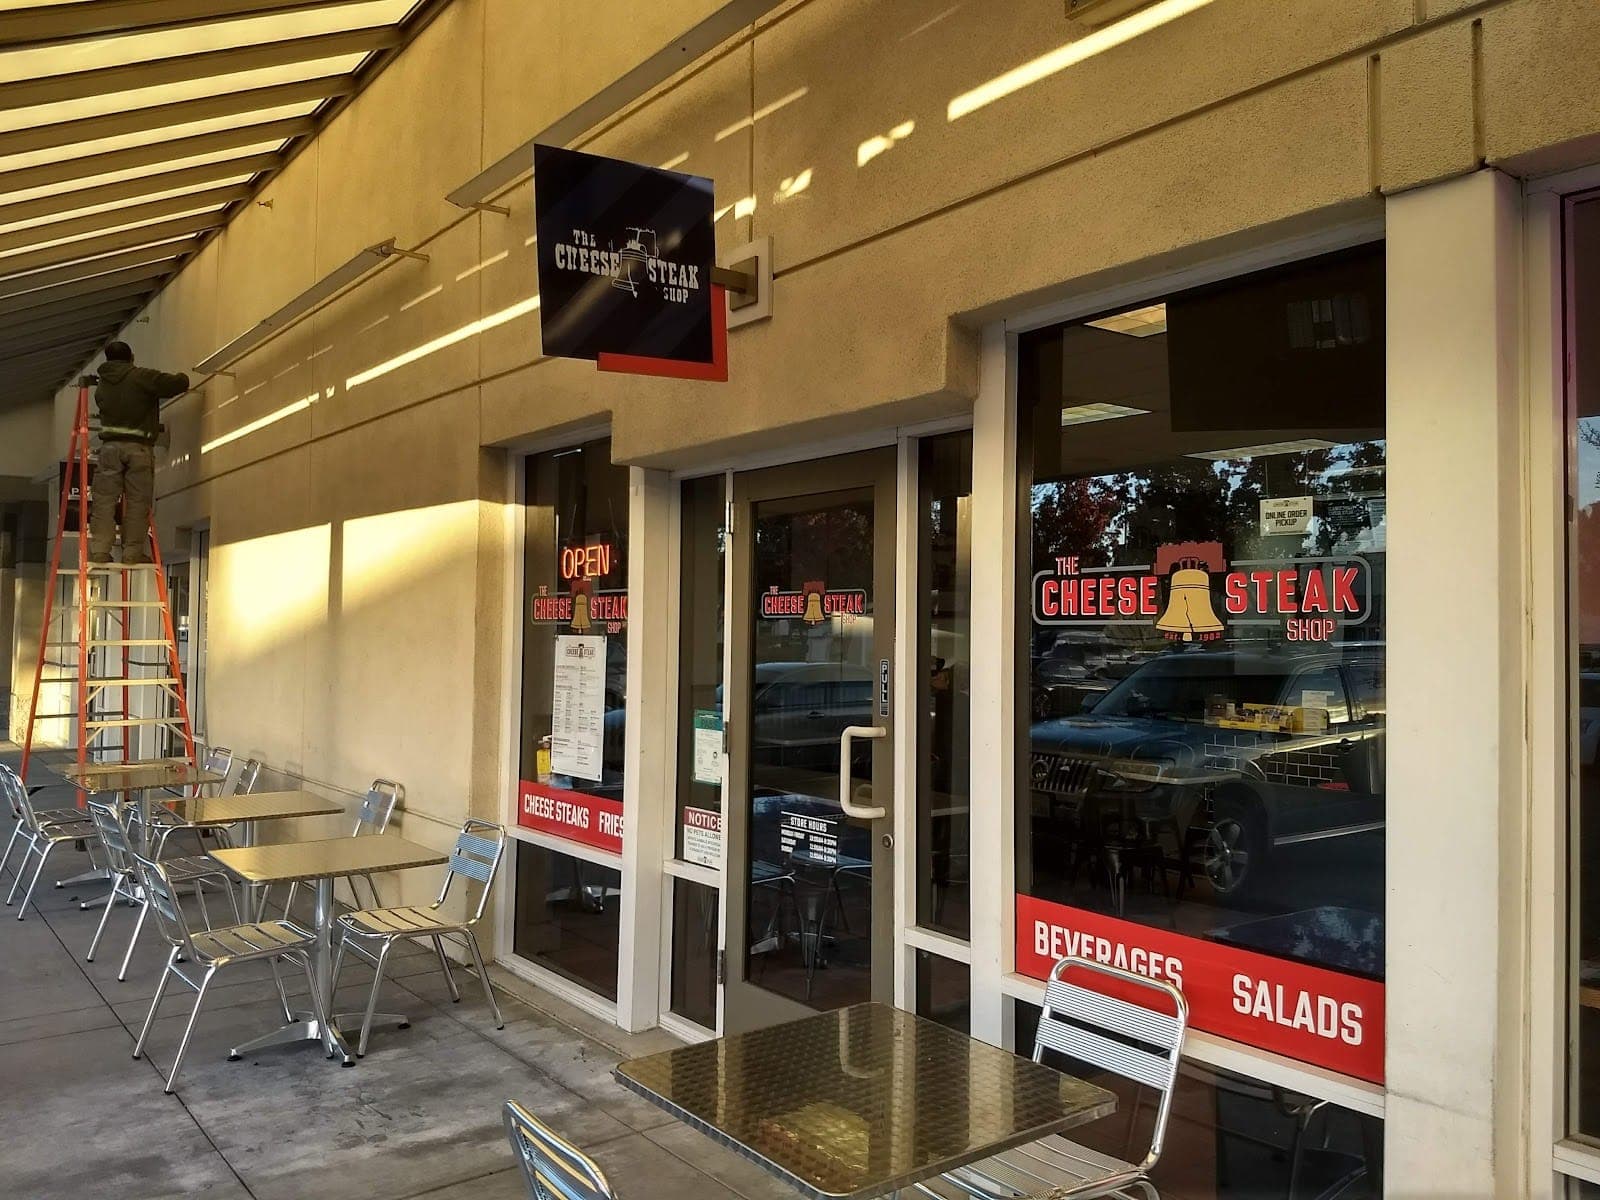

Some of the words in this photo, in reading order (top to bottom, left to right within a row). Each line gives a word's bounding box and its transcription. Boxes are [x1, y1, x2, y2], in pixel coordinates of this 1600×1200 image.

[573, 229, 596, 247] THE
[554, 243, 620, 277] CHEESE
[647, 257, 699, 289] STEAK
[663, 287, 689, 303] SHOP
[1275, 519, 1298, 527] PICKUP
[1288, 509, 1308, 518] ORDER
[563, 544, 609, 578] OPEN
[1056, 556, 1079, 575] THE
[769, 585, 779, 595] THE
[1041, 576, 1158, 616] CHEESE
[1225, 567, 1359, 614] STEAK
[533, 598, 572, 620] CHEESE
[764, 595, 805, 614] CHEESE
[824, 593, 864, 613] STEAK
[607, 622, 622, 634] SHOP
[1286, 618, 1335, 641] SHOP
[524, 793, 555, 820] CHEESE
[555, 800, 589, 829] STEAKS
[688, 811, 721, 830] NOTICE
[790, 817, 807, 828] STORE
[808, 820, 827, 832] HOURS
[1034, 920, 1183, 990] BEVERAGES
[1232, 973, 1363, 1046] SALADS
